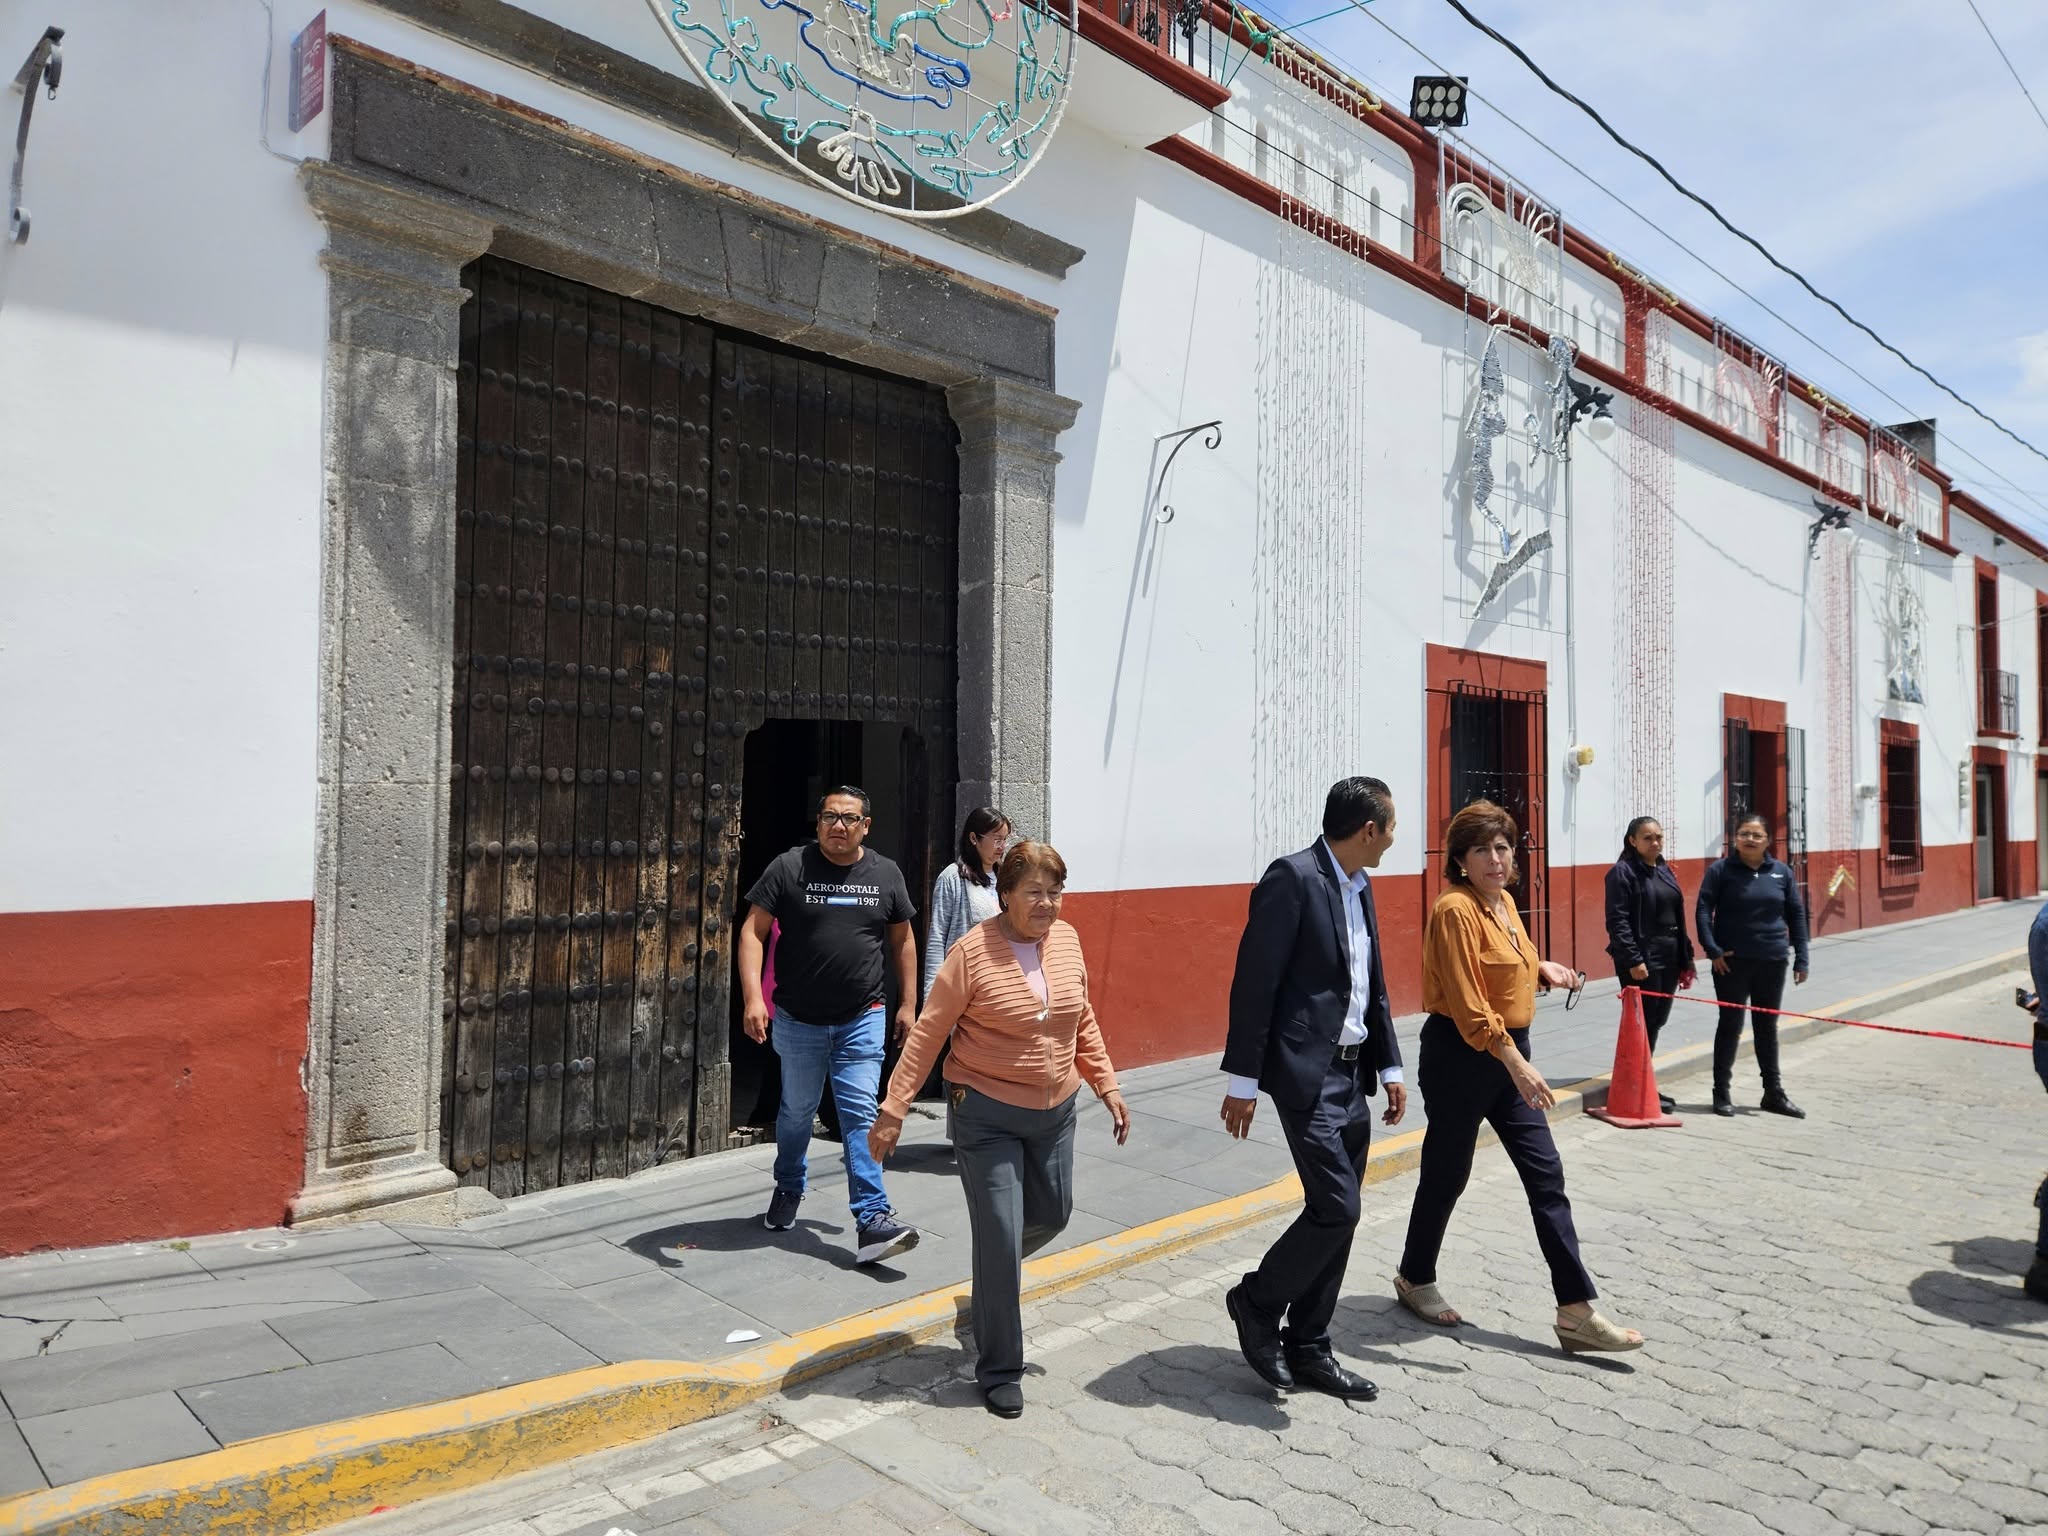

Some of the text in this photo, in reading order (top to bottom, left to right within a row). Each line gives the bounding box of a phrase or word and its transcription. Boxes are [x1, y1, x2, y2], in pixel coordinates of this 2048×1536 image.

[806, 883, 880, 895] AEROPOSTALE
[805, 895, 880, 907] EST 1987
